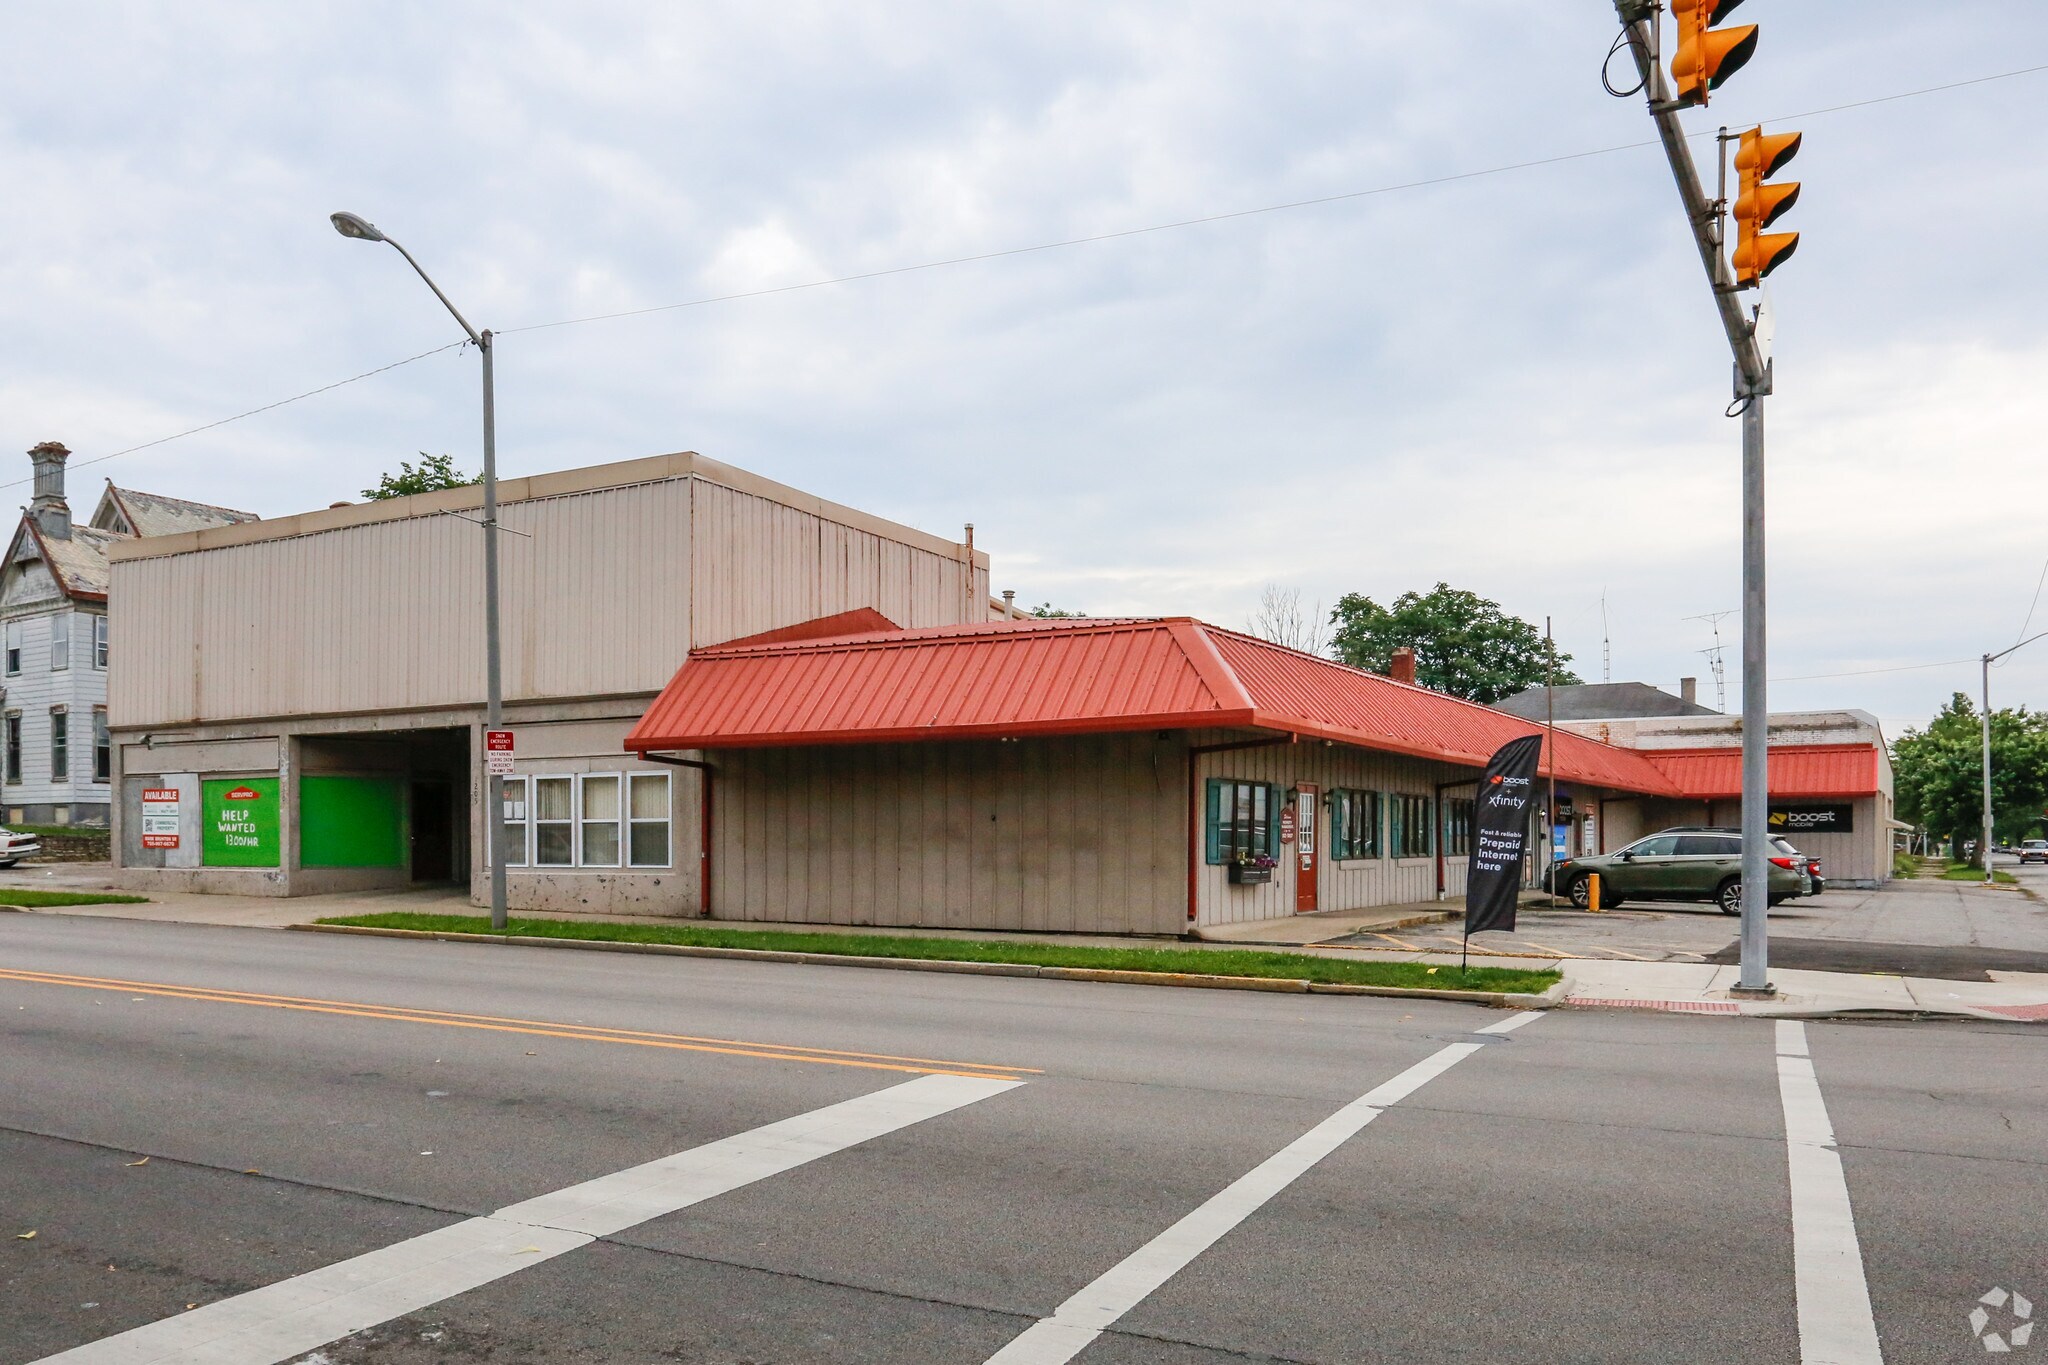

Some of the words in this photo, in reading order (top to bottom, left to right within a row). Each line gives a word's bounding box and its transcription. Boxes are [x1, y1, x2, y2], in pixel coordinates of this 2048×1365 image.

[1503, 776, 1530, 785] boost
[144, 791, 177, 800] AVAILABLE
[1488, 794, 1526, 810] xfinity
[222, 809, 249, 822] HELP
[1788, 811, 1835, 821] boost
[217, 821, 256, 833] WANTED
[1480, 828, 1494, 836] Fast
[1479, 837, 1521, 850] Prepaid
[1478, 848, 1518, 861] Internet
[1476, 860, 1502, 872] here
